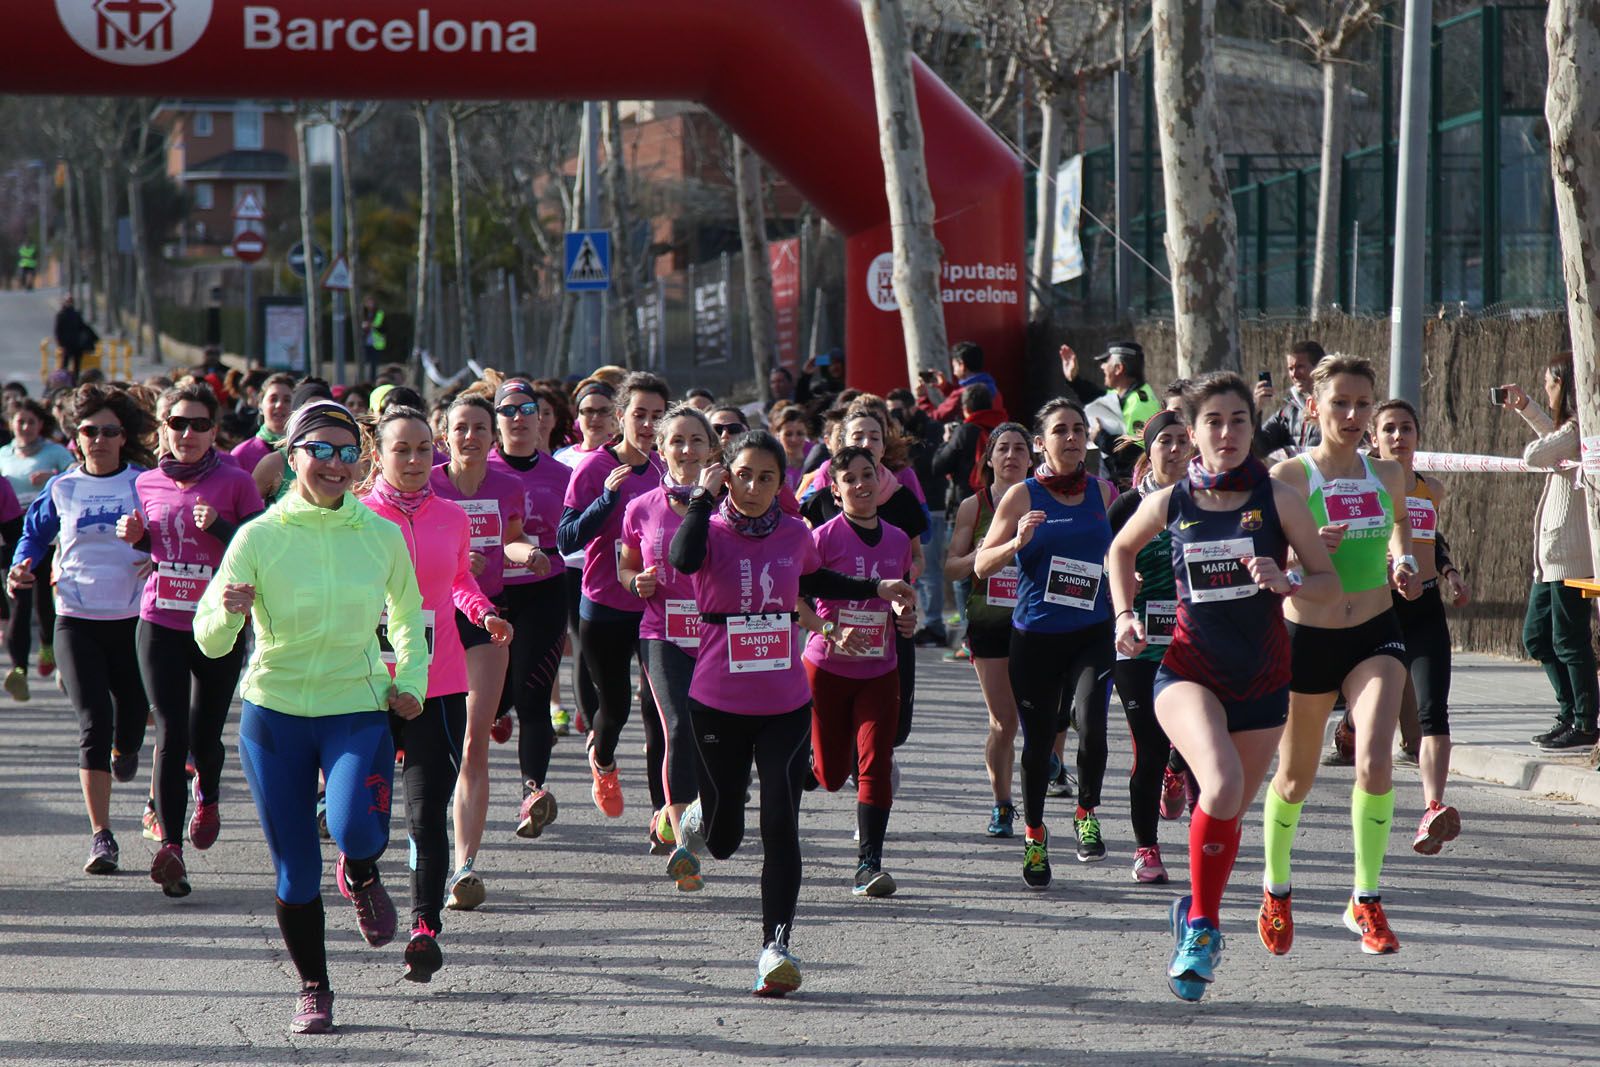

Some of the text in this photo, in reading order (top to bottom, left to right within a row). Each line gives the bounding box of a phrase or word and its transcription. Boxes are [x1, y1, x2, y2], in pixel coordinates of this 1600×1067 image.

[243, 5, 537, 52] Barcelona
[943, 261, 1017, 282] iputació
[942, 286, 1017, 304] arcelona
[1349, 505, 1362, 516] 35
[1201, 561, 1239, 574] MARTA
[740, 559, 752, 597] MILLES
[1058, 574, 1091, 588] SANDRA
[1209, 573, 1233, 587] 211
[169, 580, 196, 590] MARIA
[996, 580, 1017, 588] SAND
[175, 590, 188, 599] 42
[1064, 585, 1083, 597] 202
[685, 616, 703, 625] EVA
[1155, 616, 1177, 624] TAMA
[740, 635, 781, 646] SANDRA
[754, 646, 769, 657] 39
